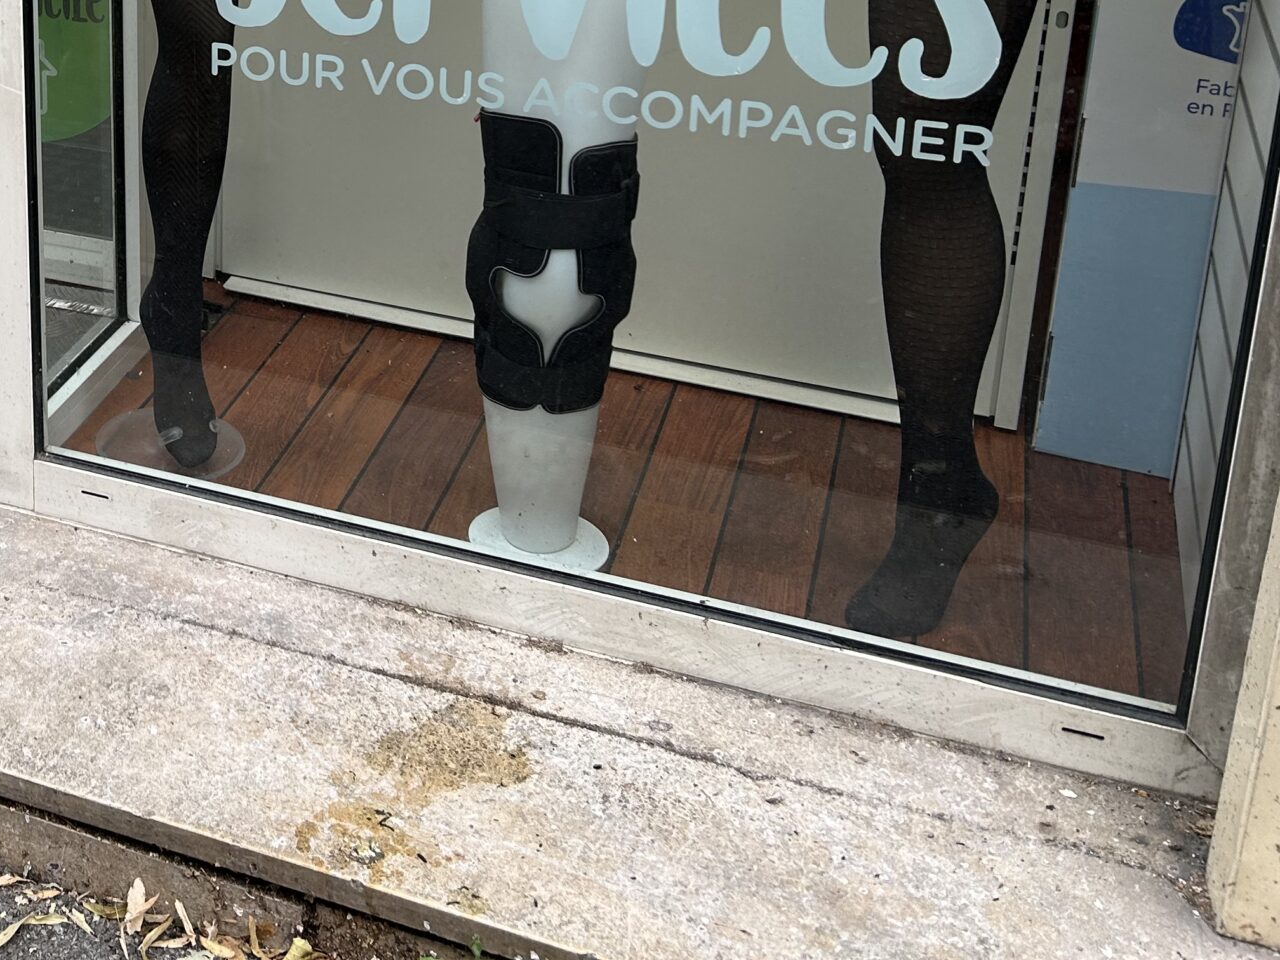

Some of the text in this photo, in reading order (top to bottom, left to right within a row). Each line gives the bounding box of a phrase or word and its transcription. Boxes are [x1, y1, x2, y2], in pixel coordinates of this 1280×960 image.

[211, 42, 994, 167] POUR VOUS ACCOMPAGNER
[1187, 102, 1214, 116] en
